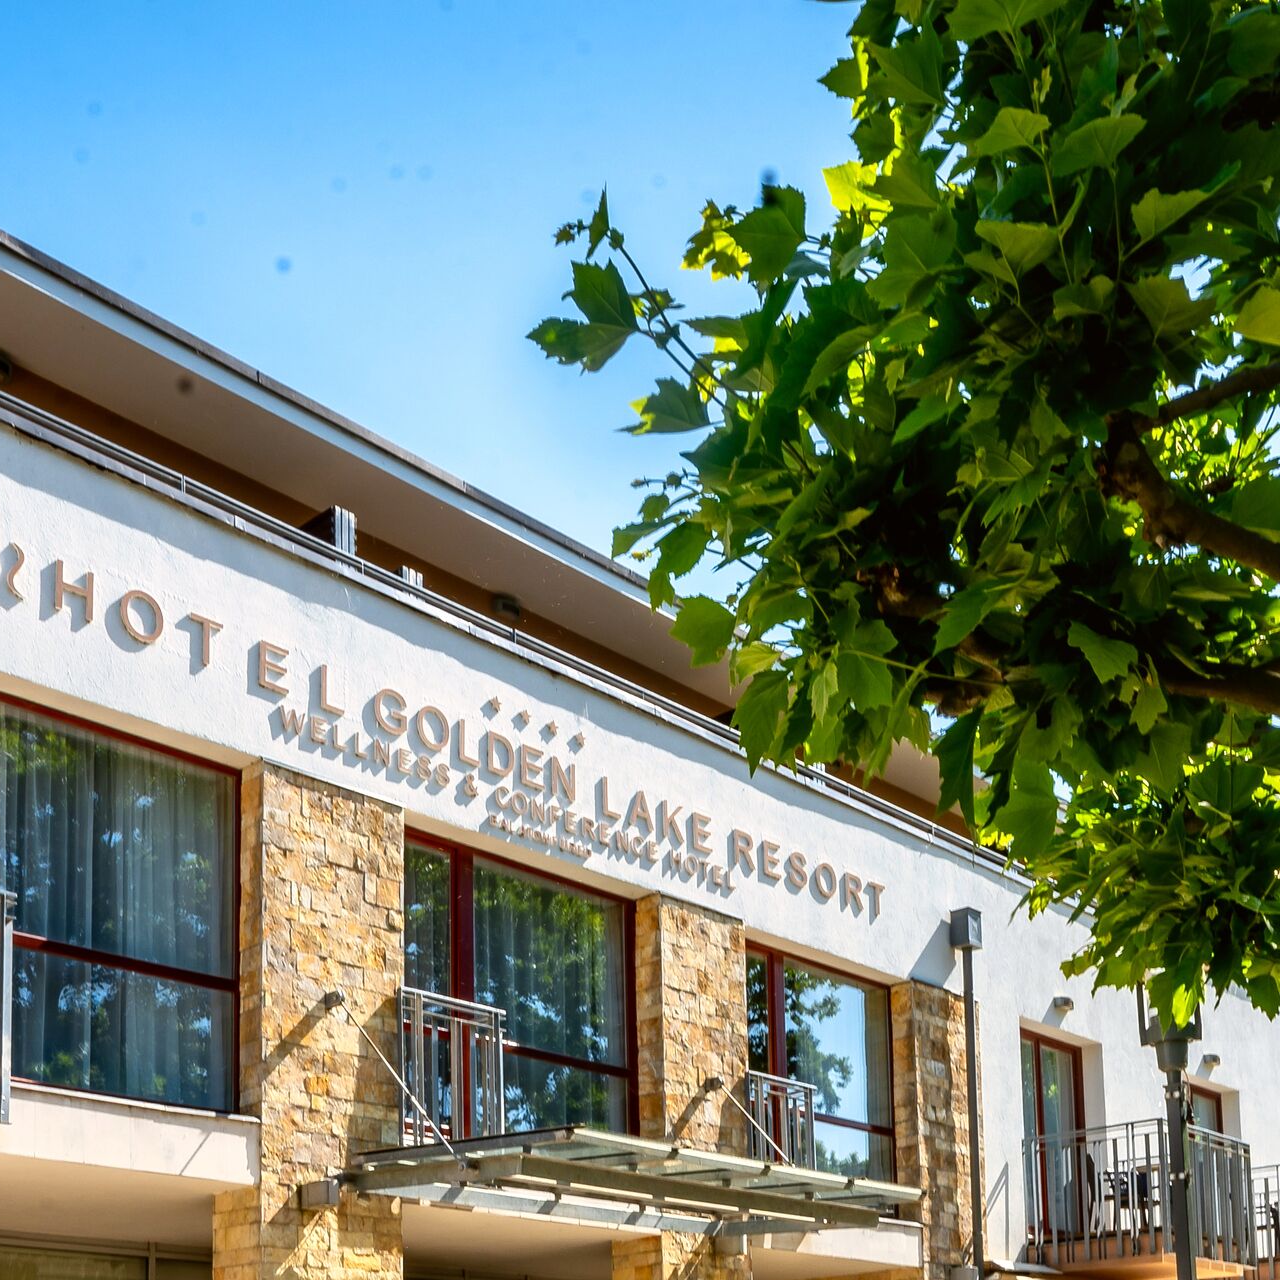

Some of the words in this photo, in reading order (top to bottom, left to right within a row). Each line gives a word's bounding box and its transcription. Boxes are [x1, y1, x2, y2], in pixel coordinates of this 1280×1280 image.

[54, 559, 345, 716] HOTEL
[373, 688, 577, 801] GOLDEN
[601, 776, 713, 854] LAKE
[732, 828, 886, 916] RESORT
[279, 704, 451, 788] WELLNESS
[463, 773, 480, 798] &
[495, 786, 659, 863] CONFERENCE
[670, 849, 737, 891] HOTEL
